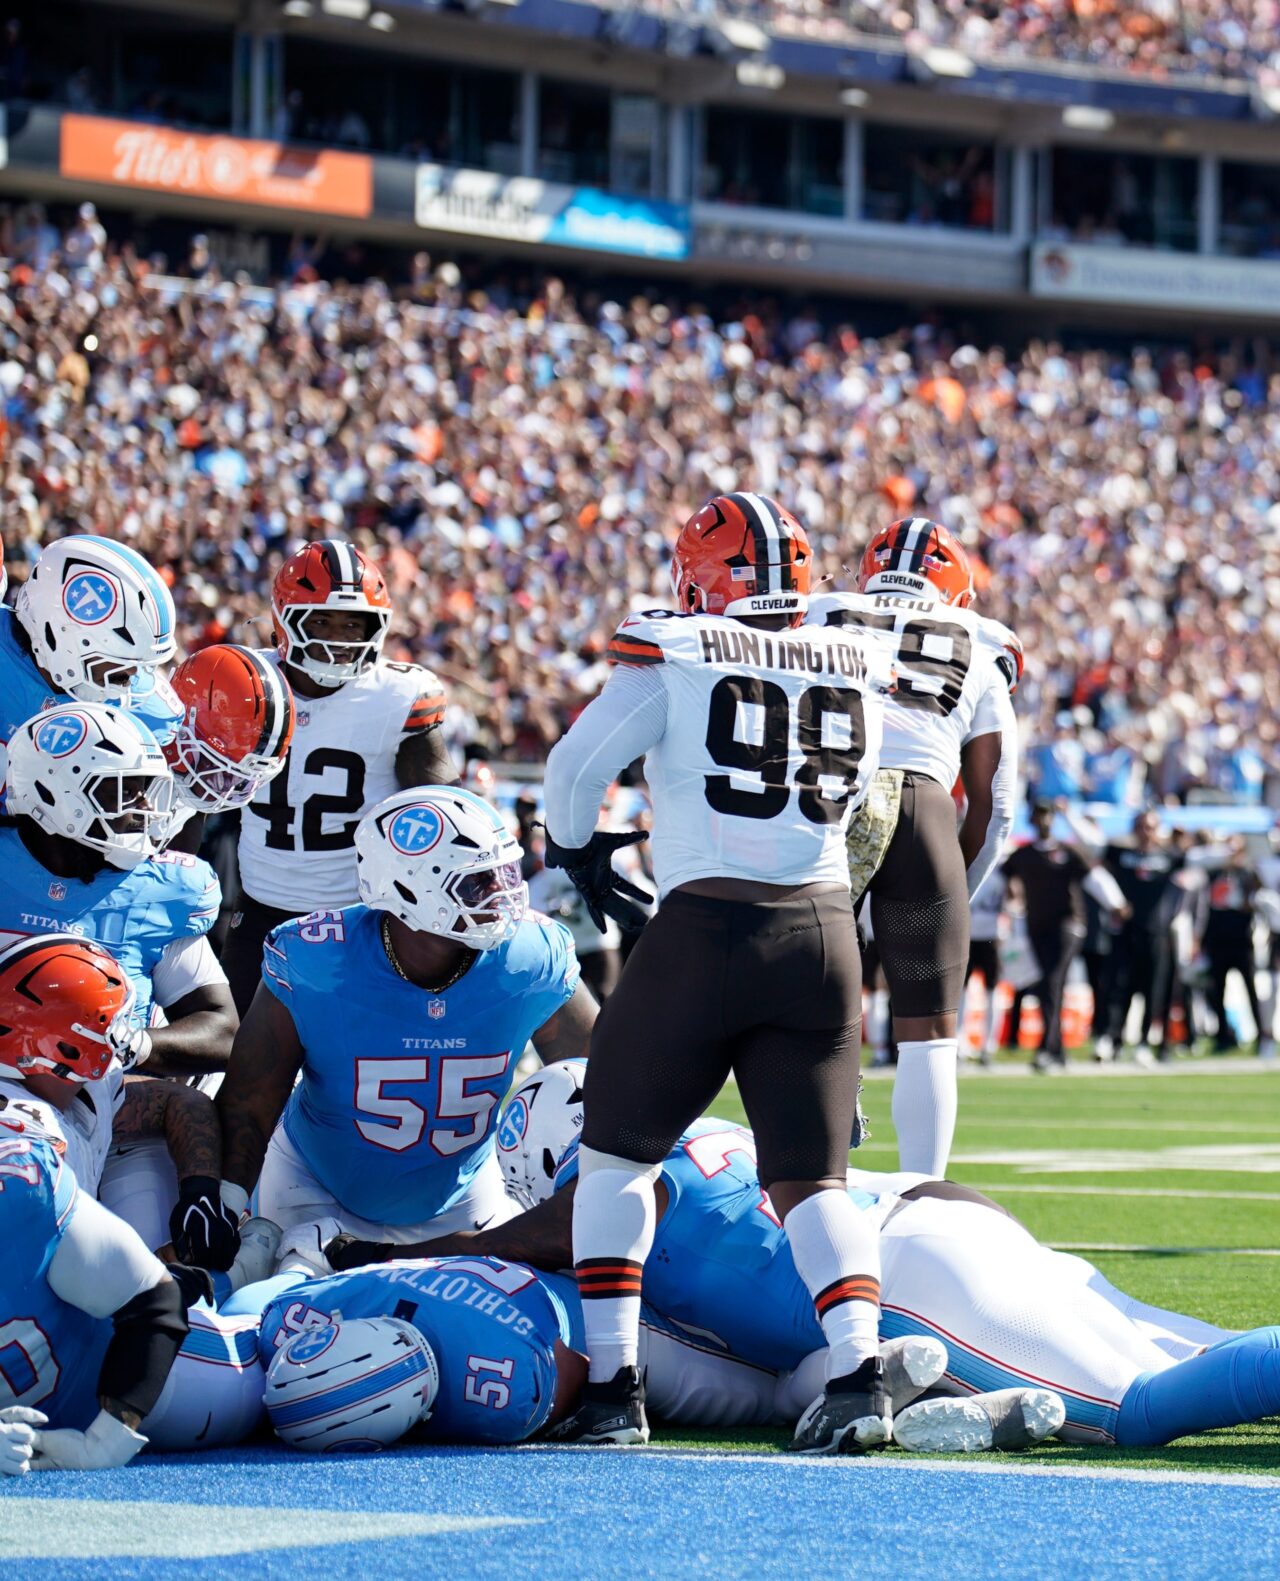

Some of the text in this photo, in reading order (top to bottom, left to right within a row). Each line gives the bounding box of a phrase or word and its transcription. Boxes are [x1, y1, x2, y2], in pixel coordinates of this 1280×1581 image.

[113, 129, 200, 188] Tito's
[751, 599, 799, 610] CLEVELAND
[880, 573, 924, 590] CLEVELAND
[699, 629, 867, 683] HUNTINGTON
[704, 675, 867, 824] 98
[20, 912, 85, 936] TITANS
[402, 1037, 467, 1049] TITANS
[352, 1051, 509, 1157] 55
[464, 1354, 515, 1410] 51
